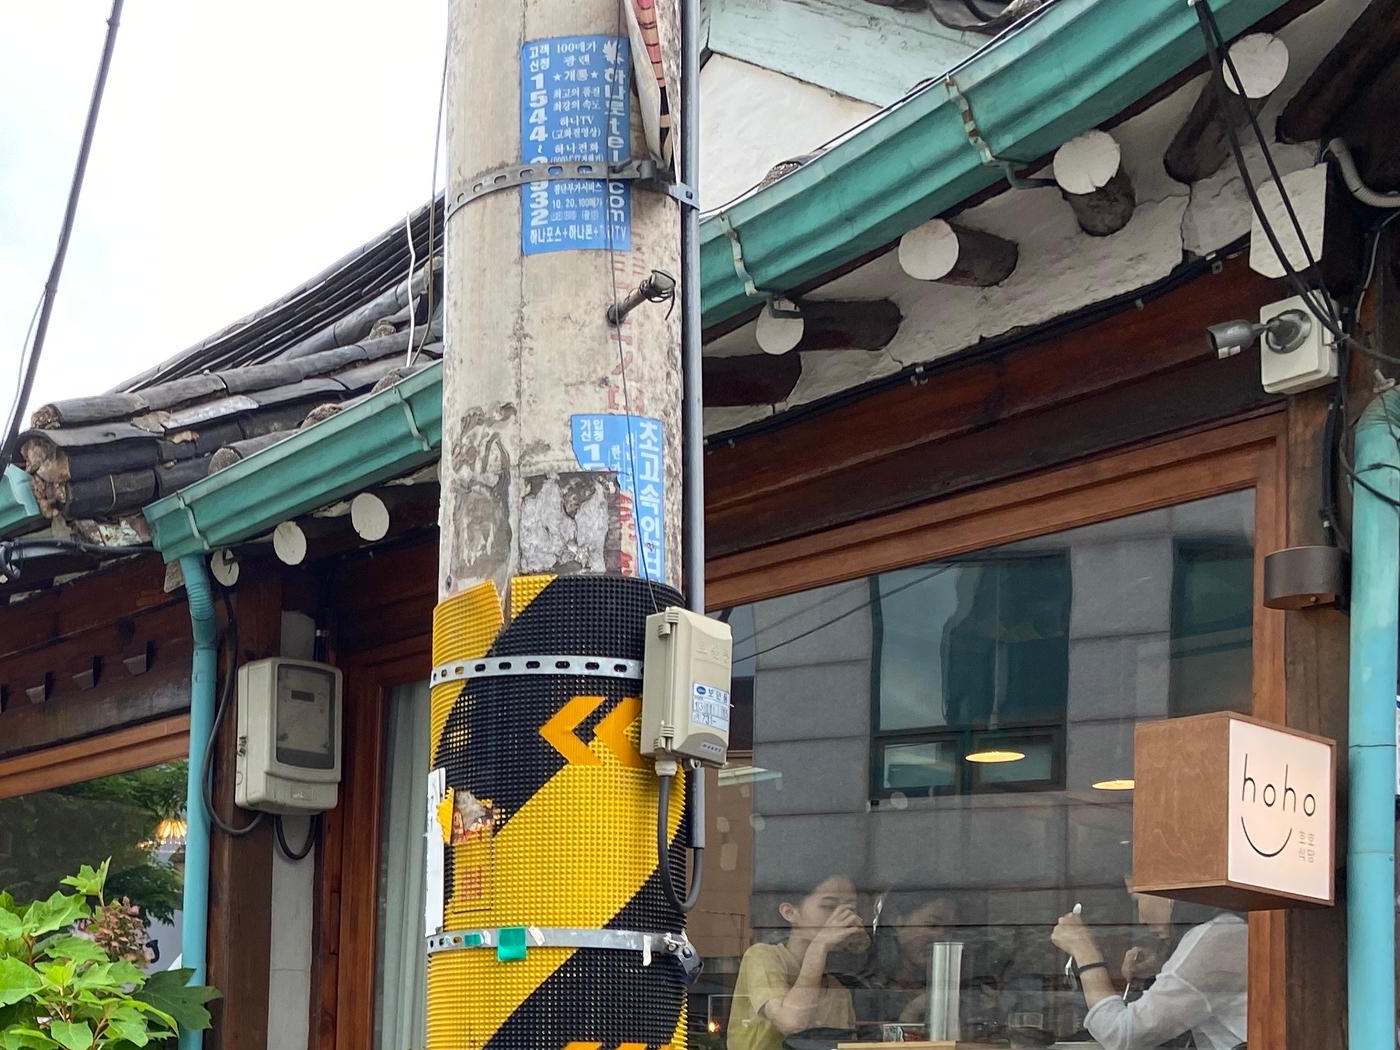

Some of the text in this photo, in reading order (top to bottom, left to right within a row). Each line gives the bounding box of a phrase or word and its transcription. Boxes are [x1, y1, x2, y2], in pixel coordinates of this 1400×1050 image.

[580, 419, 604, 431] 가입
[580, 430, 604, 442] 신청
[1242, 753, 1316, 817] hoho
